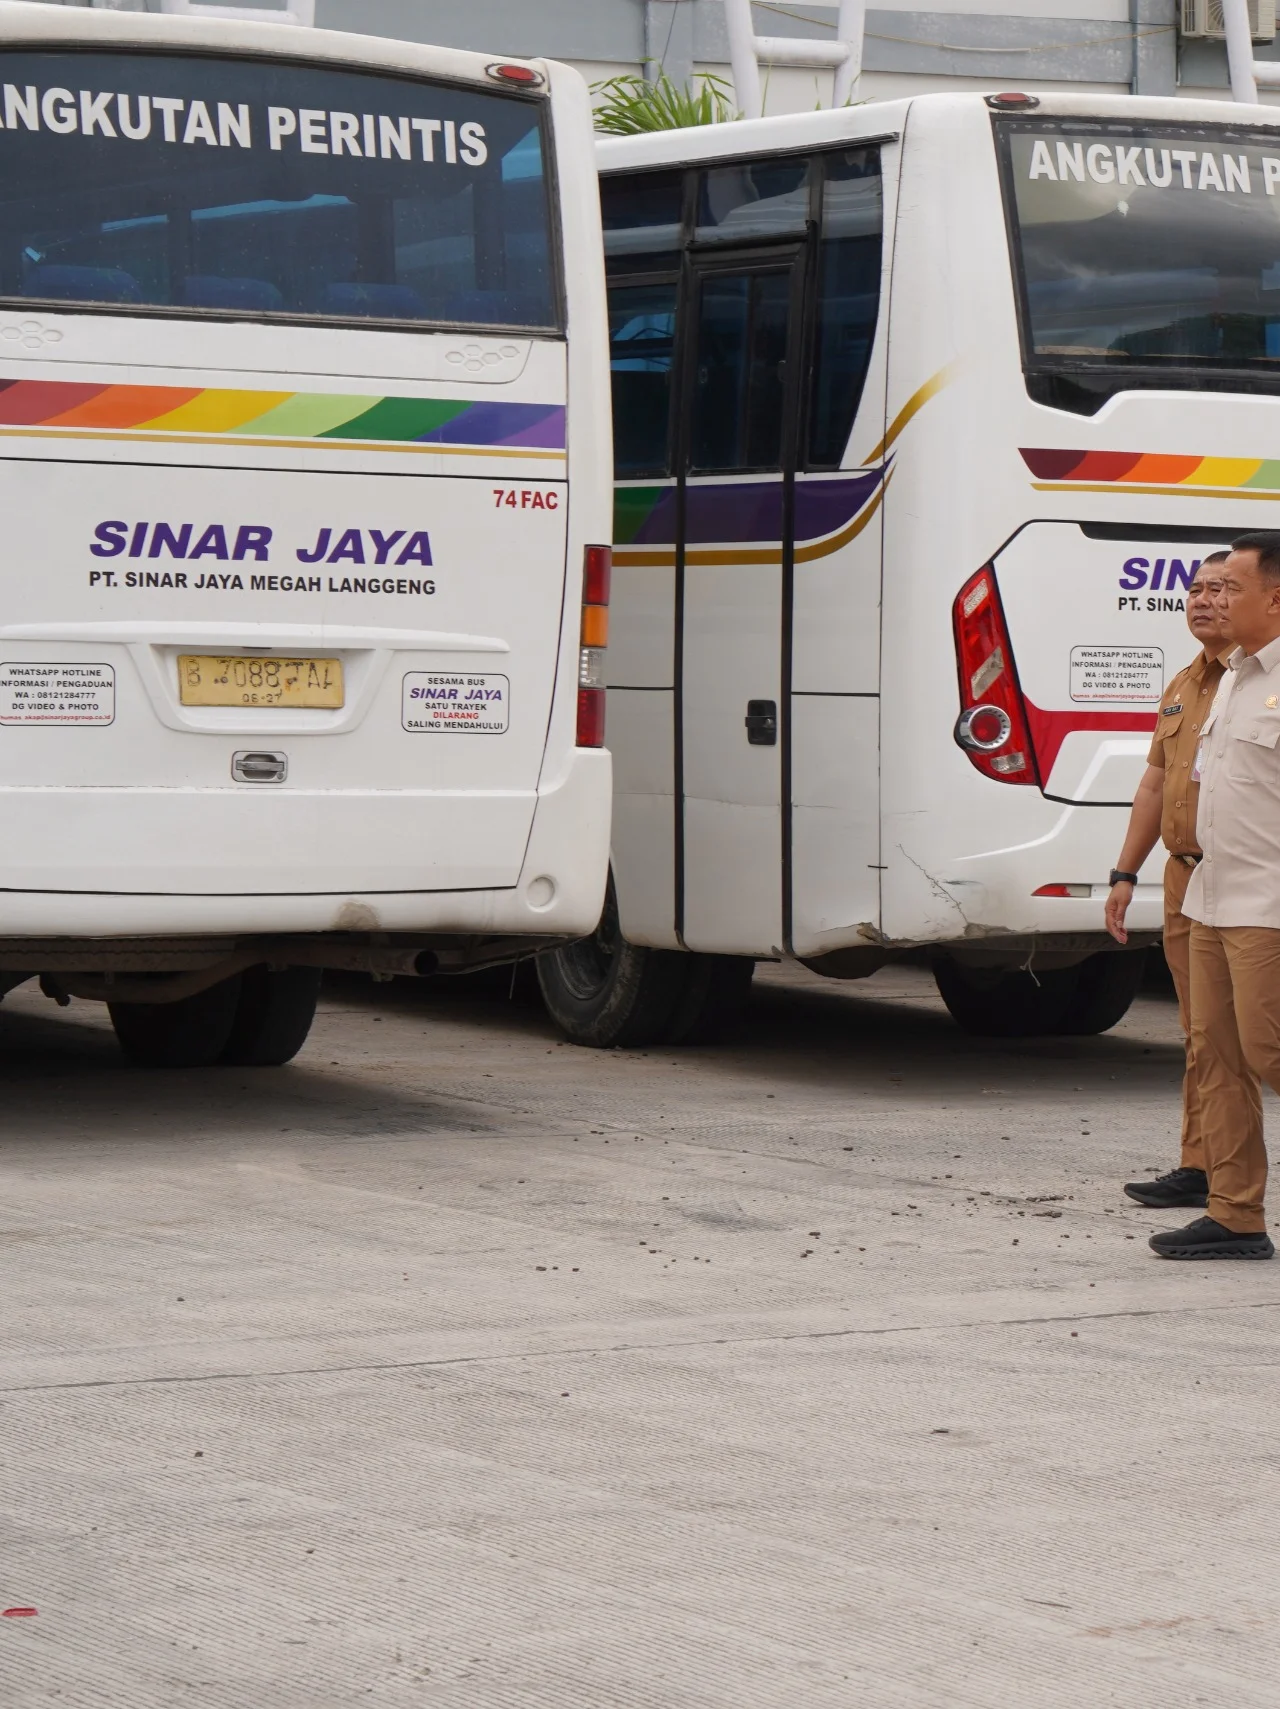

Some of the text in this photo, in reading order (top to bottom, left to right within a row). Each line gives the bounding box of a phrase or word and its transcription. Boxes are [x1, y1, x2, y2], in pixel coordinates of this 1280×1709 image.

[0, 84, 488, 166] NGKUTAN PERINTIS
[1029, 140, 1251, 194] ANGKUTAN
[493, 489, 558, 510] 74 FAC
[89, 520, 433, 566] SINAR JAYA
[89, 571, 436, 595] PT. SINAR JAYA MEGAH LANGGENG
[1118, 557, 1201, 591] SIN
[1118, 597, 1186, 613] PT. SINA
[428, 677, 465, 685] SESAMA
[410, 688, 502, 700] SINAR JAYA
[408, 720, 503, 729] SALING MENDAHULUI
[433, 711, 479, 719] DILARANG
